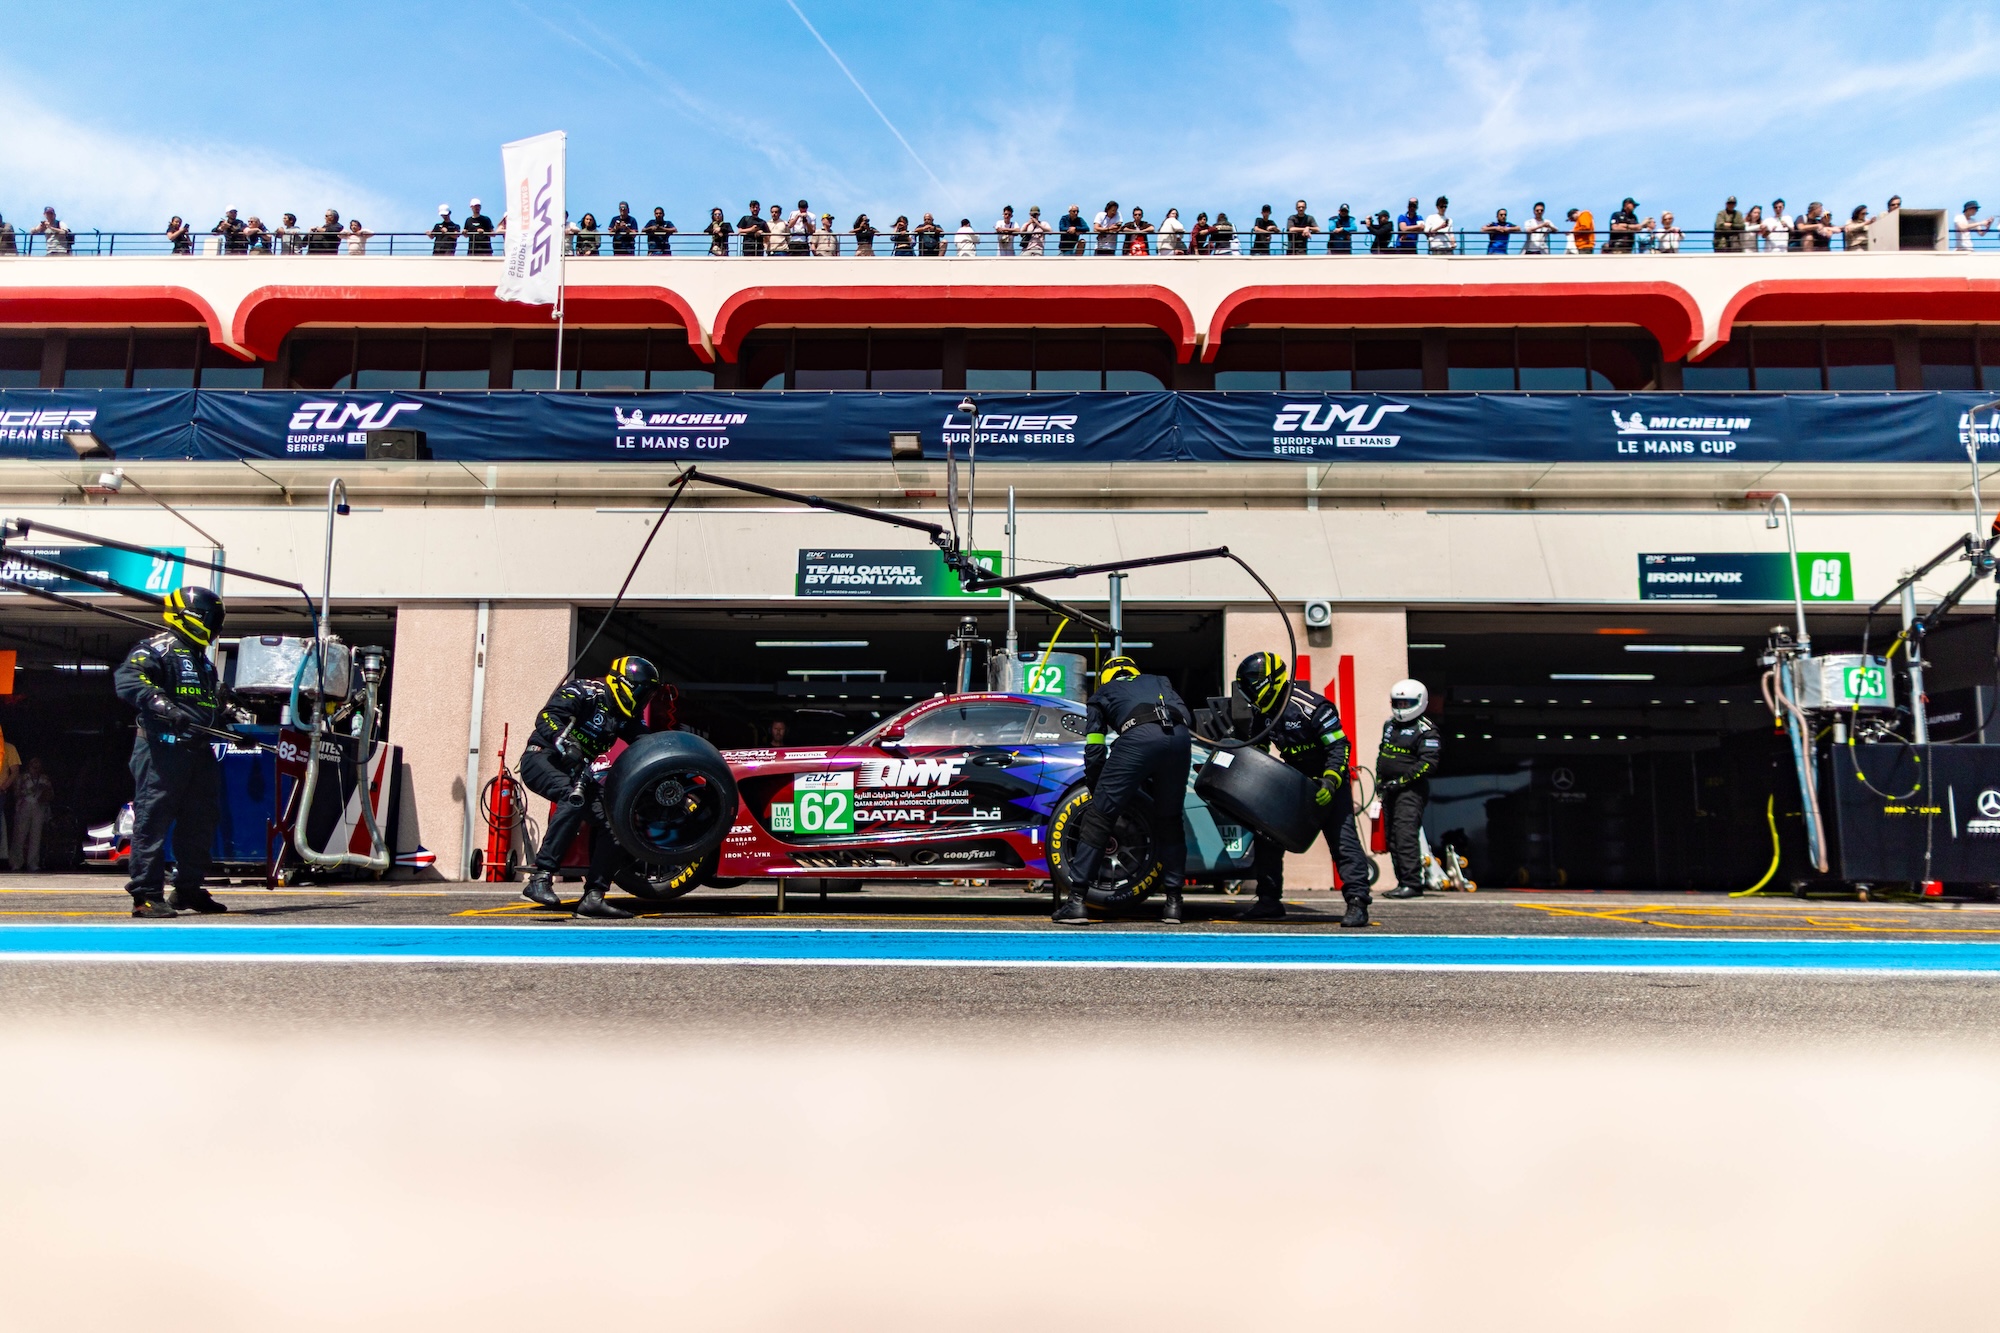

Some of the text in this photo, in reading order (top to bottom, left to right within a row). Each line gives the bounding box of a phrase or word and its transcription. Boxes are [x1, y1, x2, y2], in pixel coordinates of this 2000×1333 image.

[0, 411, 97, 426] GIER
[288, 402, 424, 430] ELMS
[648, 413, 748, 425] MICHELIN
[1272, 403, 1411, 432] ELMS
[1649, 416, 1752, 429] MICHELIN
[287, 434, 367, 444] EUROPEAN LE
[616, 436, 731, 449] LE MANS CUP
[1023, 433, 1076, 444] SERIES
[1272, 436, 1392, 446] EUROPEAN LE MANS
[286, 443, 325, 452] SERIES
[1273, 445, 1314, 455] SERIES
[1617, 440, 1737, 454] LE MANS CUP
[145, 551, 175, 590] 21
[806, 565, 916, 576] TEAM QATAR
[804, 574, 923, 586] BY IRON LYNX
[1646, 572, 1743, 583] IRON LYNX
[1809, 559, 1842, 597] 63
[1028, 666, 1063, 694] 62
[1847, 668, 1883, 697] 63
[175, 686, 202, 695] IRON
[279, 740, 298, 762] 62
[318, 754, 341, 763] SPORTS
[775, 806, 790, 817] LM
[800, 792, 848, 831] 62
[853, 808, 926, 822] QATAR
[774, 817, 792, 828] GT3
[1052, 791, 1093, 850] GOODYE
[943, 849, 996, 860] GOODYEAR
[670, 861, 701, 890] YEAR
[1131, 861, 1163, 896] EAGLE
